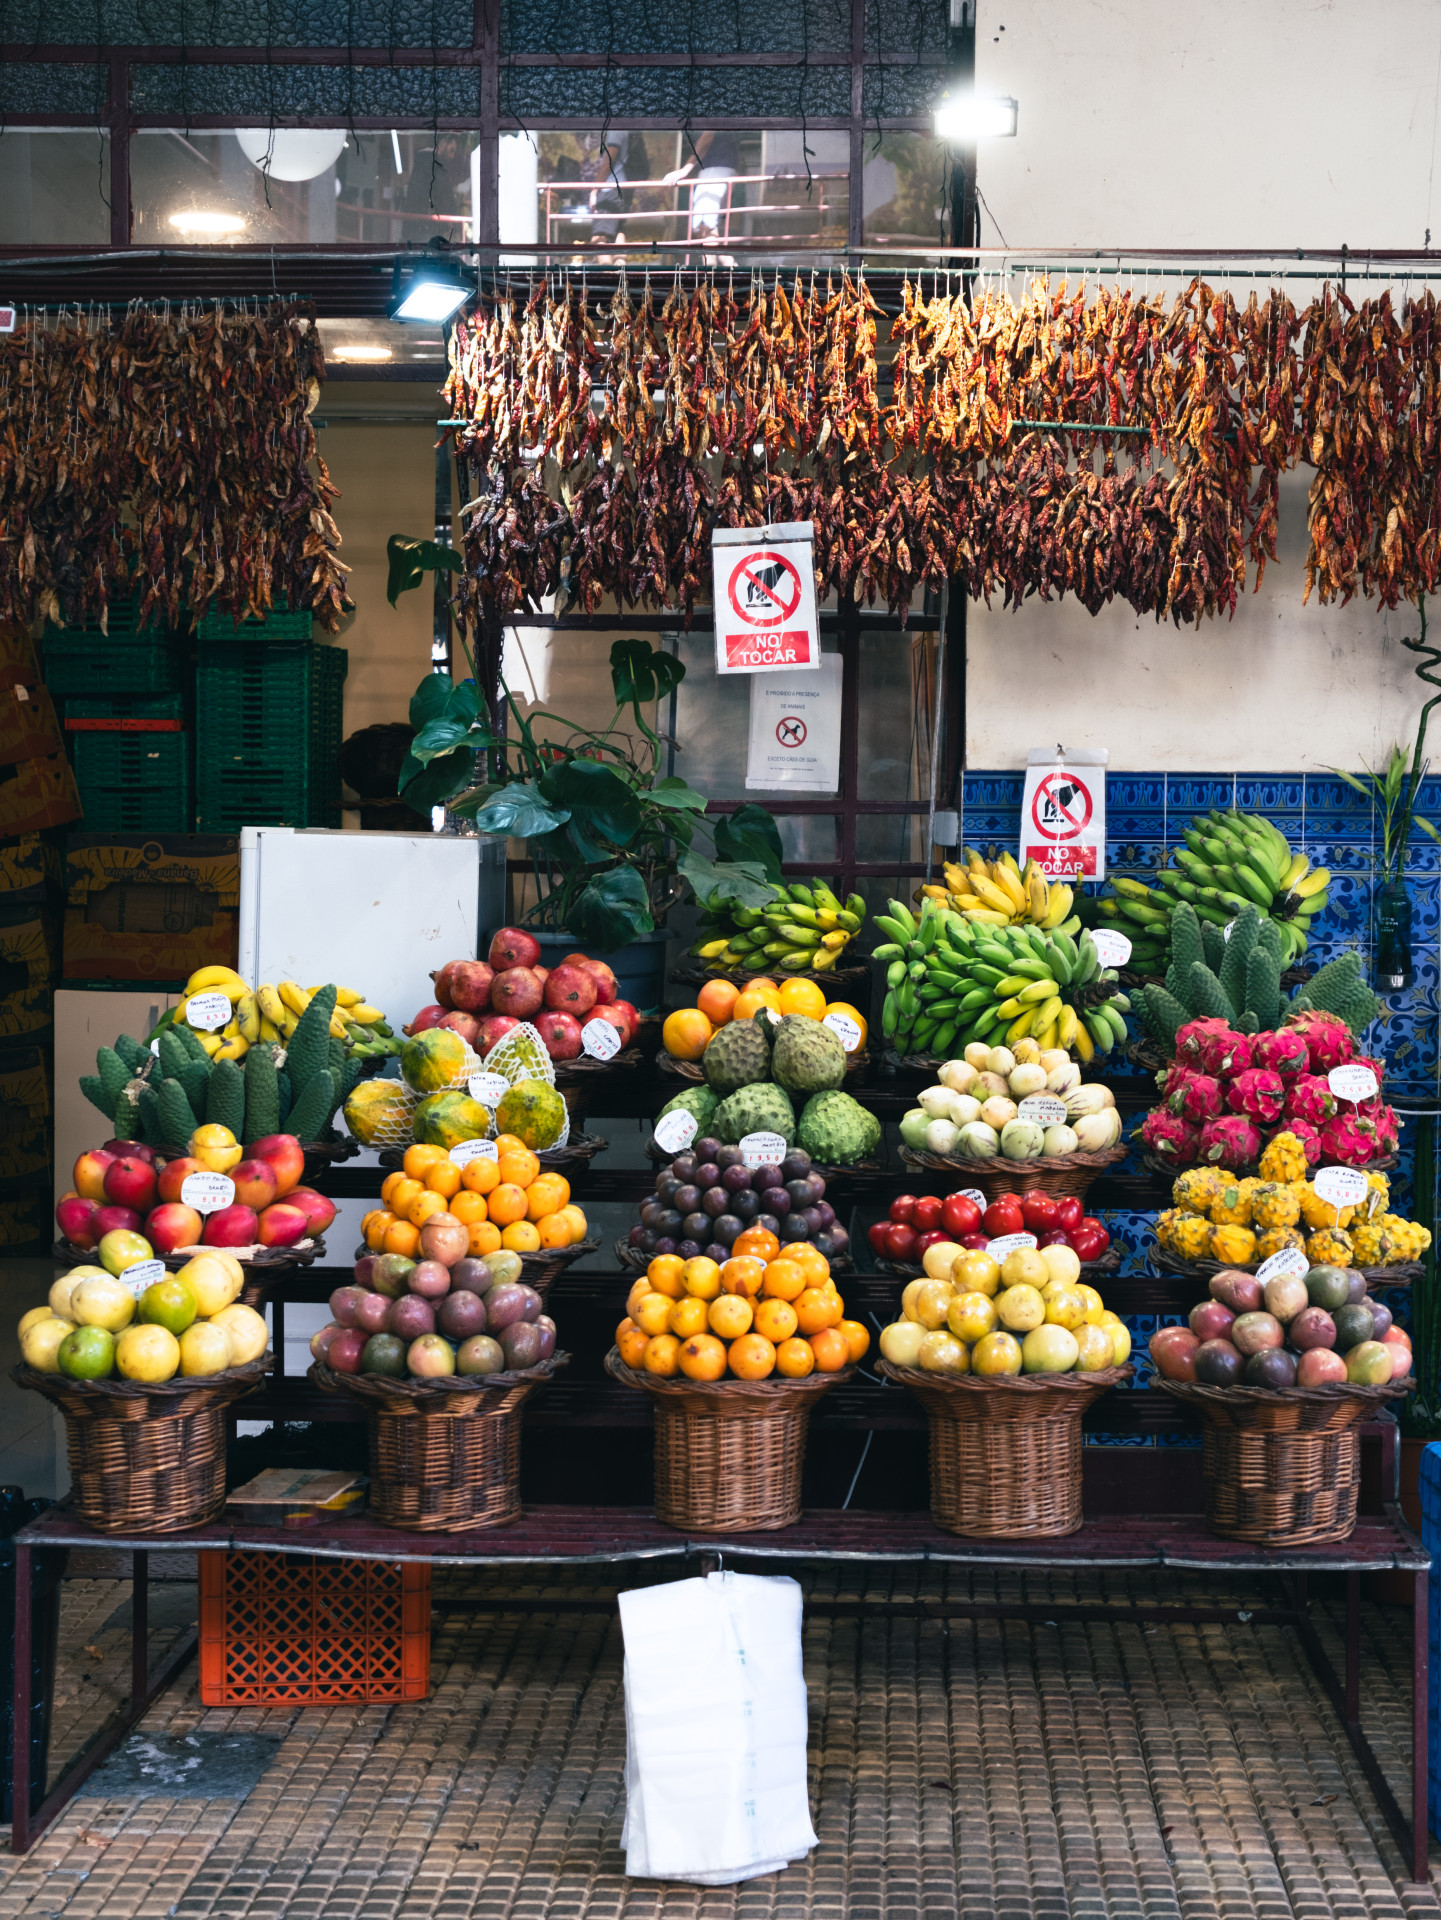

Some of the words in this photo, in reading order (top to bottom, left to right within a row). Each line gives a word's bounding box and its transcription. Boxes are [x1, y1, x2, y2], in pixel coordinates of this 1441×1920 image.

[756, 634, 780, 648] NO
[740, 649, 796, 664] TOCAR
[1048, 847, 1070, 859] NO
